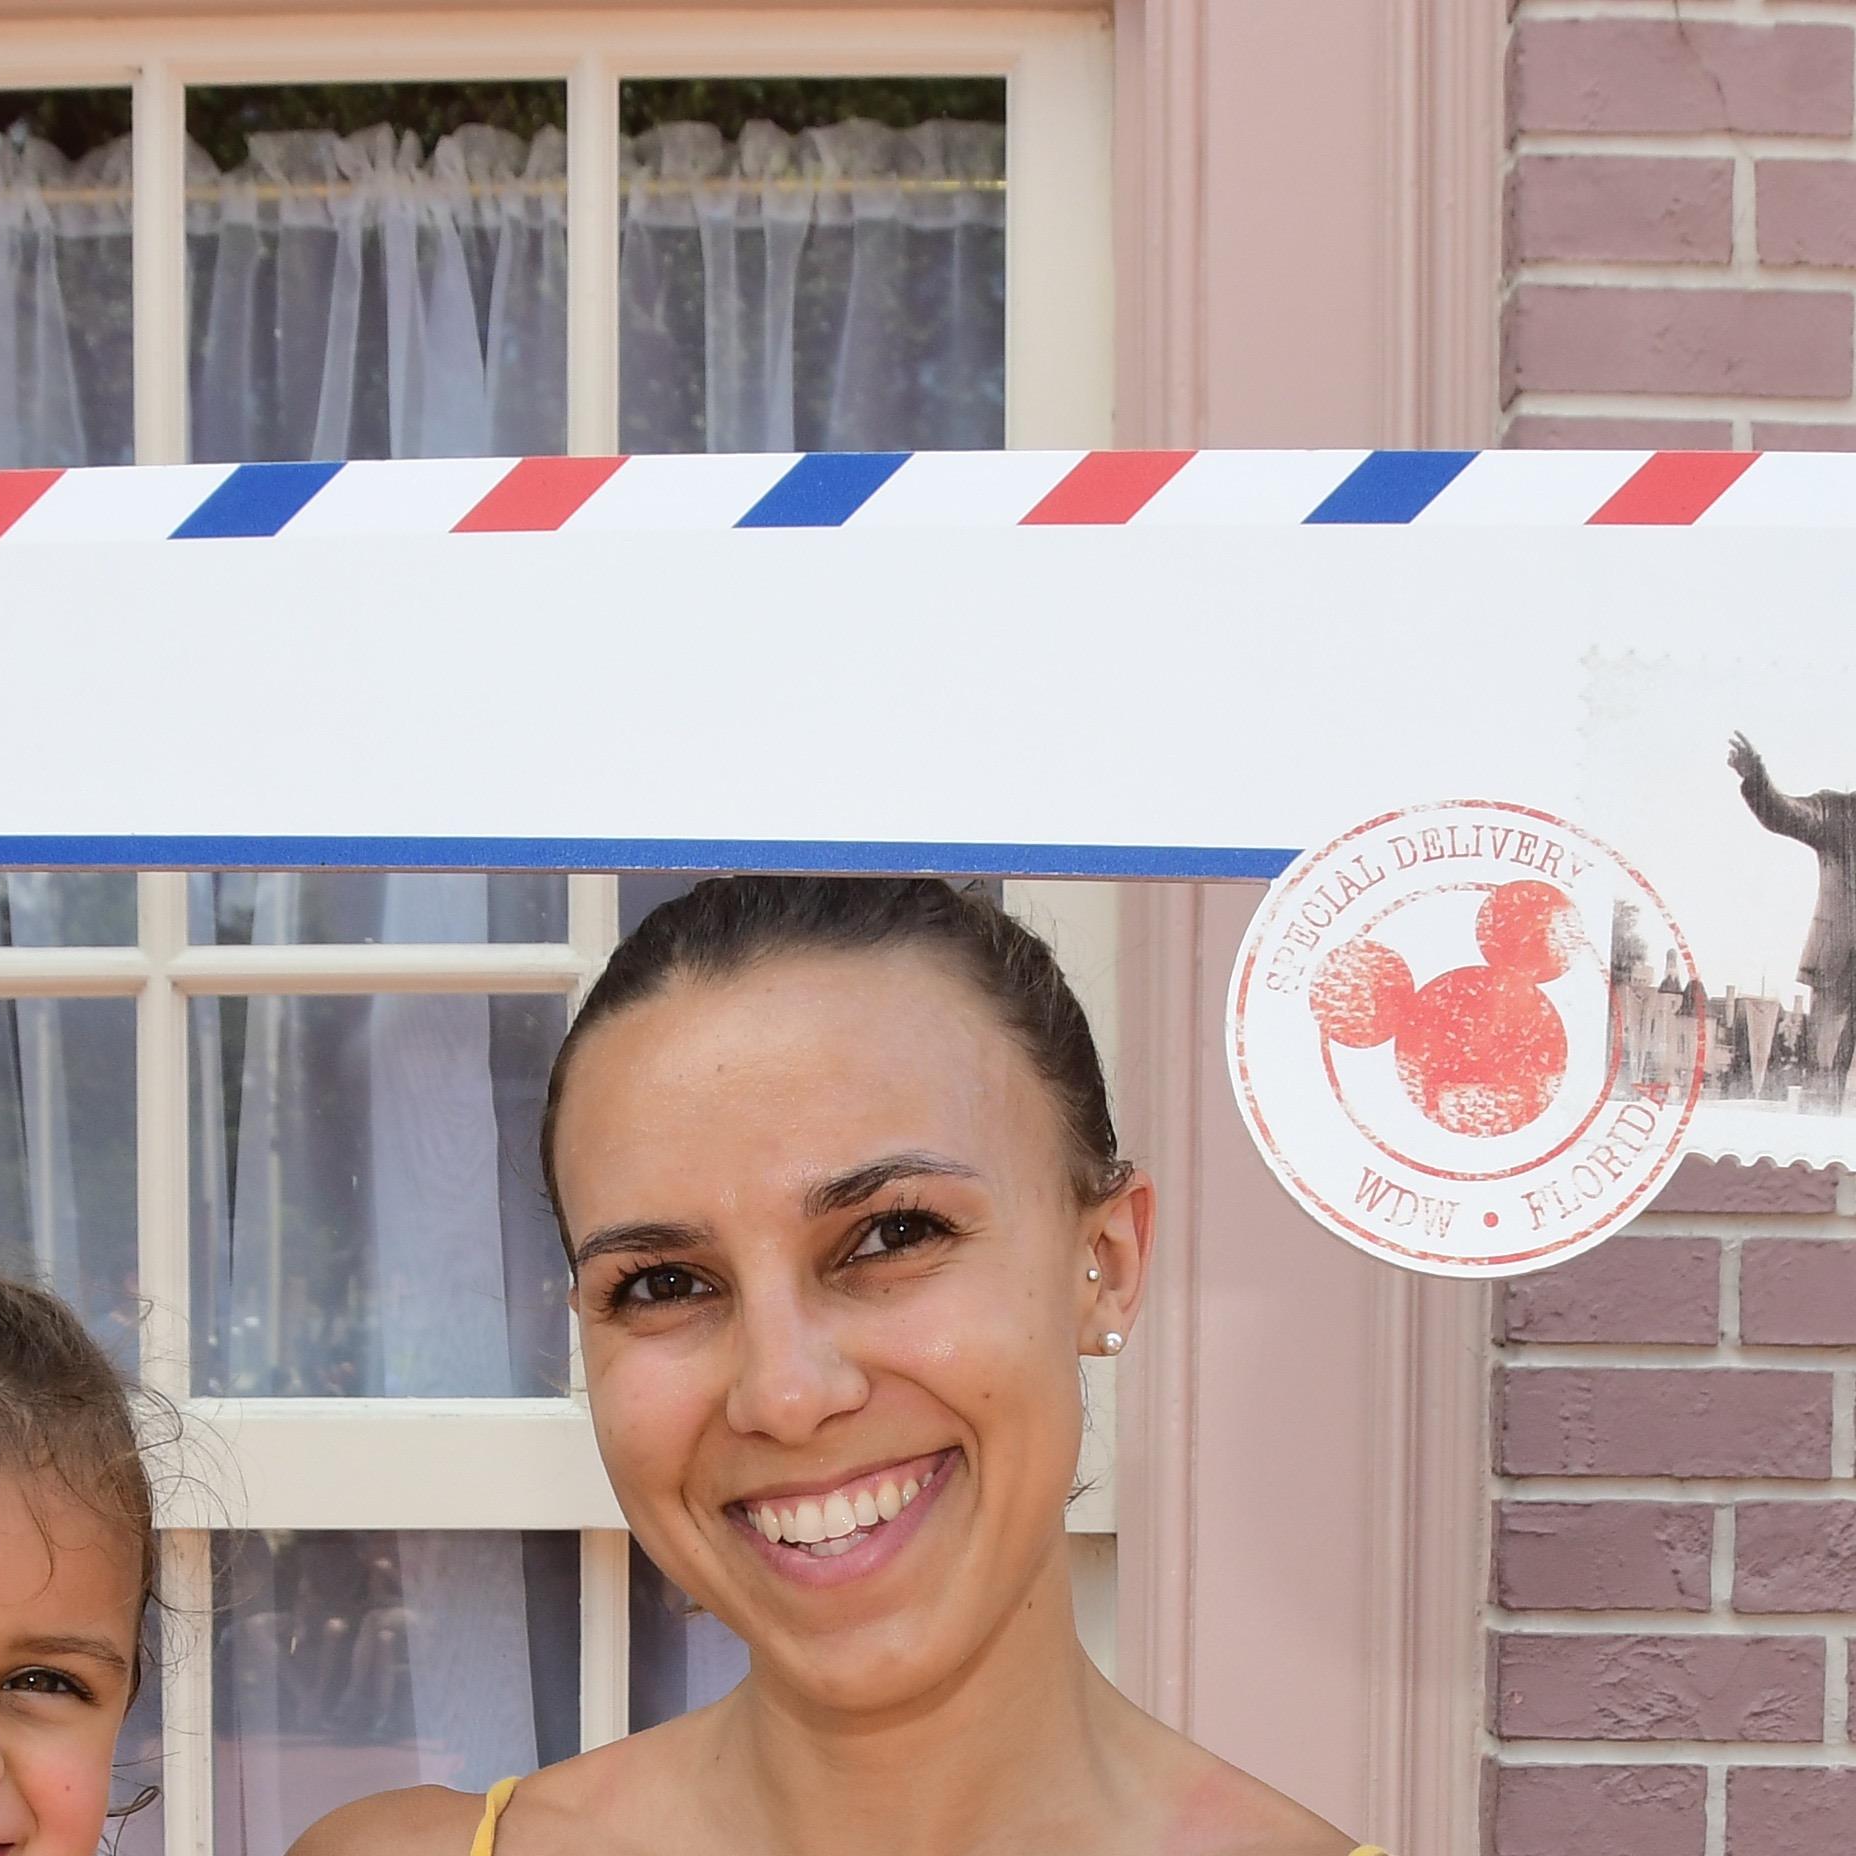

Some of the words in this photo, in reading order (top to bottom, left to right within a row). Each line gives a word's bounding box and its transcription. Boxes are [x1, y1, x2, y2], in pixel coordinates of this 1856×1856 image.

[1265, 854, 1386, 996] SPECIAL
[1387, 824, 1595, 890] DELIVERY
[1353, 1166, 1461, 1239] WDW
[1521, 1080, 1672, 1231] FLORIDA
